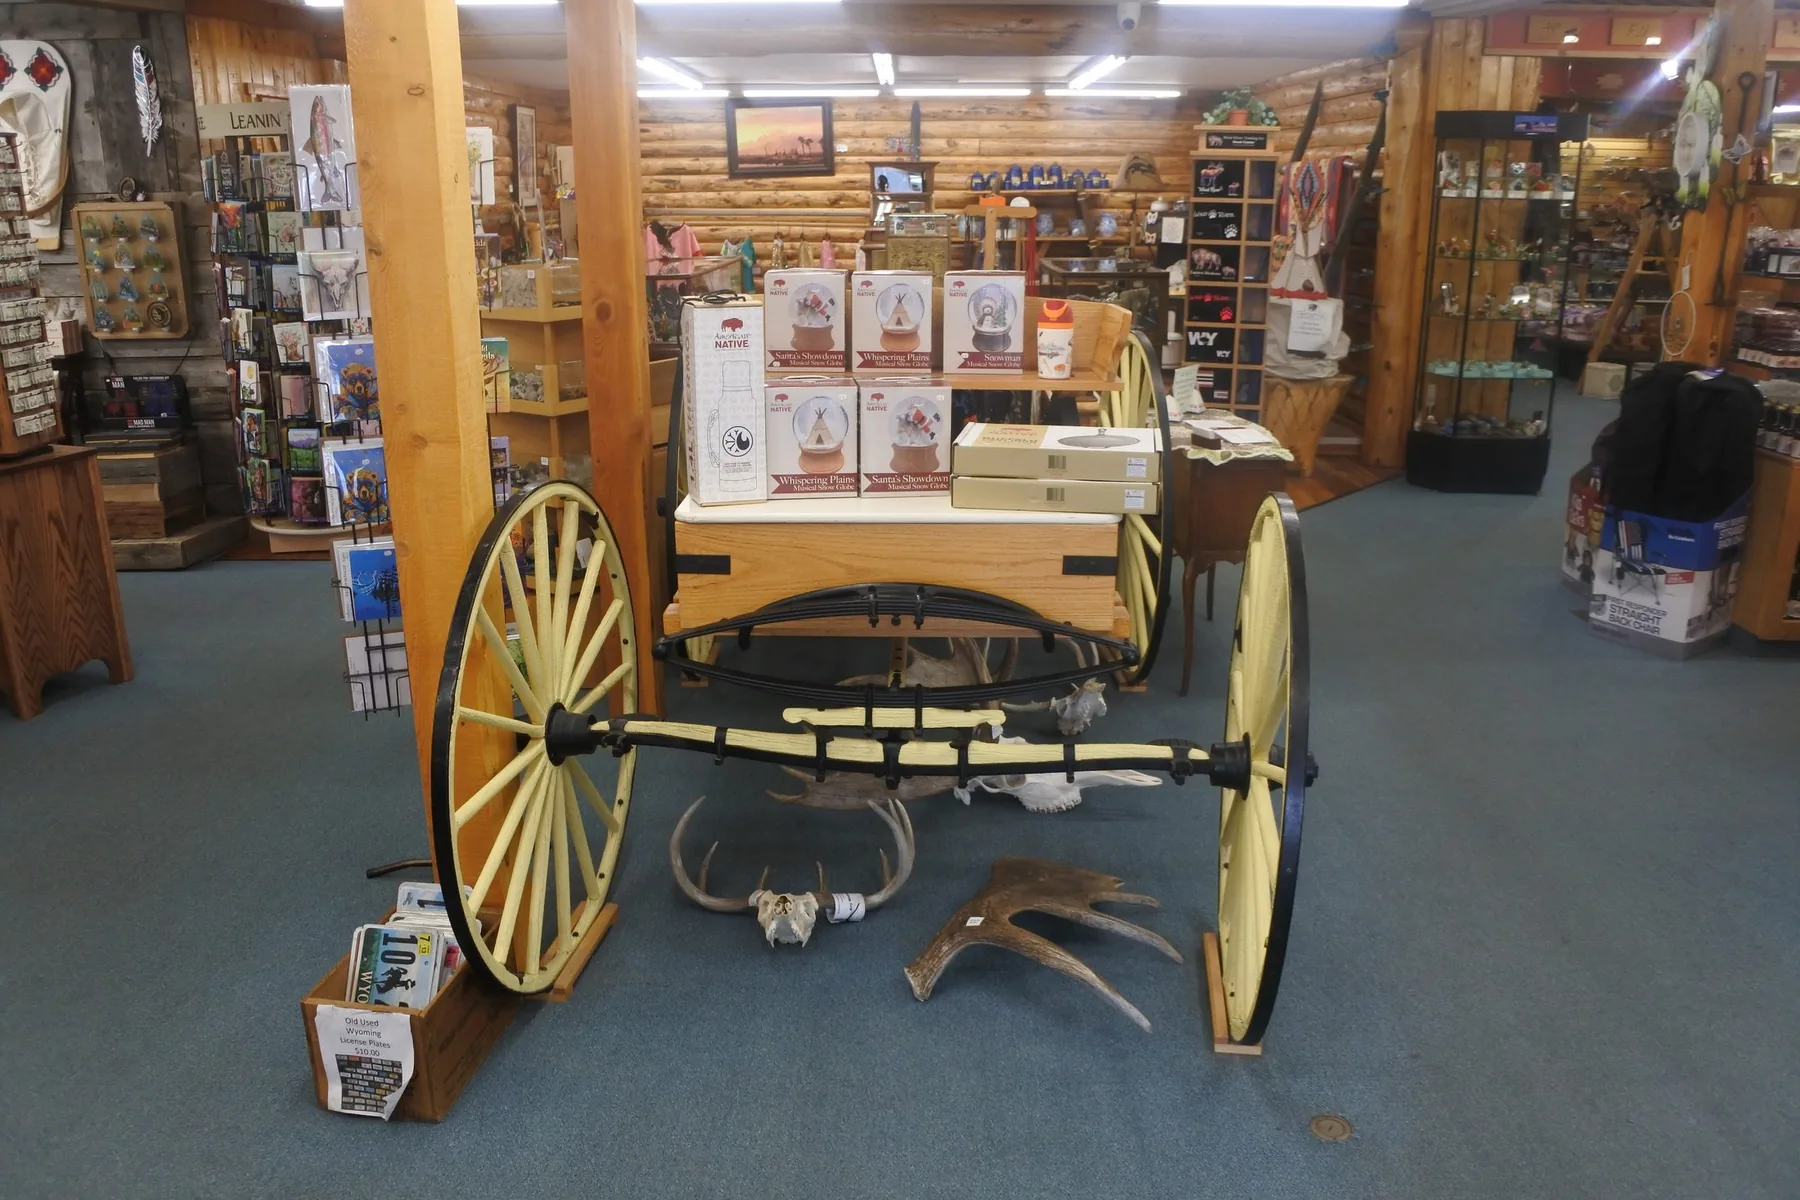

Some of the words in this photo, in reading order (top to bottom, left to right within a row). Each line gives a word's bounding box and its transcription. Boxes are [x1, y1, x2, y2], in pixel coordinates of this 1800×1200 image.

[714, 340, 750, 349] NATIVE
[775, 352, 802, 360] Santa's
[802, 352, 843, 361] Showdown
[864, 352, 906, 362] Whispering
[908, 353, 930, 361] Plains
[984, 354, 1021, 362] Snowman
[780, 476, 828, 486] Whispering
[830, 475, 855, 485] Plains
[872, 475, 900, 484] Santa's
[902, 474, 949, 483] Showdown
[793, 484, 817, 492] Musical
[836, 483, 854, 491] Globe
[1610, 603, 1662, 626] STRAIGHT
[1608, 614, 1632, 627] BACK
[1633, 620, 1661, 635] CHAIR
[344, 1017, 358, 1025] Old
[360, 1018, 379, 1027] Used
[346, 1028, 382, 1039] Wyoming
[340, 1036, 367, 1046] License
[368, 1040, 392, 1048] Plates
[354, 1047, 380, 1056] $10.00
